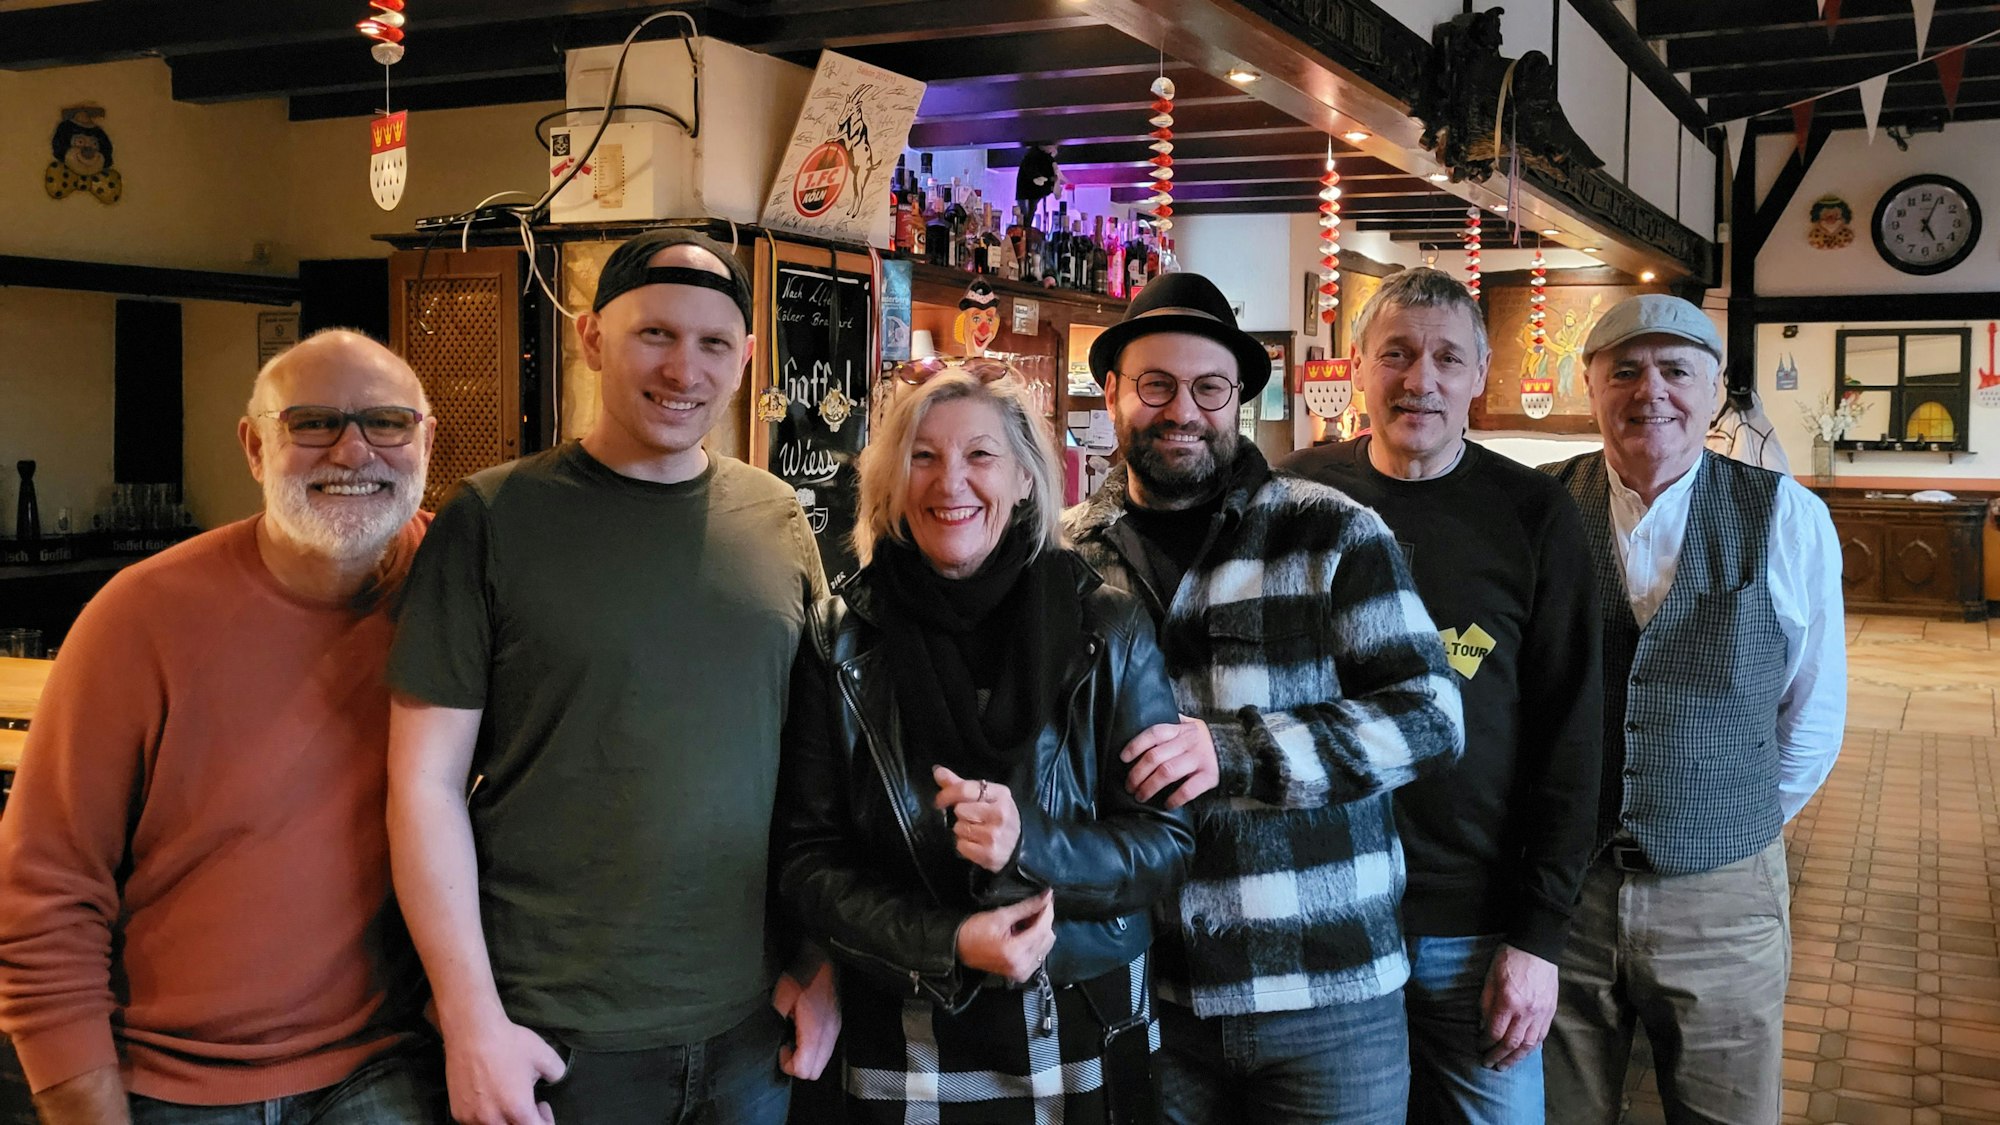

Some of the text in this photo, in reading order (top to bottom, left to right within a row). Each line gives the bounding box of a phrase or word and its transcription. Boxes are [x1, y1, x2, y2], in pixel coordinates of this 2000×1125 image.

[801, 188, 828, 204] KÖLN
[781, 275, 804, 299] Nach
[783, 356, 858, 409] Gaffl
[779, 438, 840, 477] Wiess
